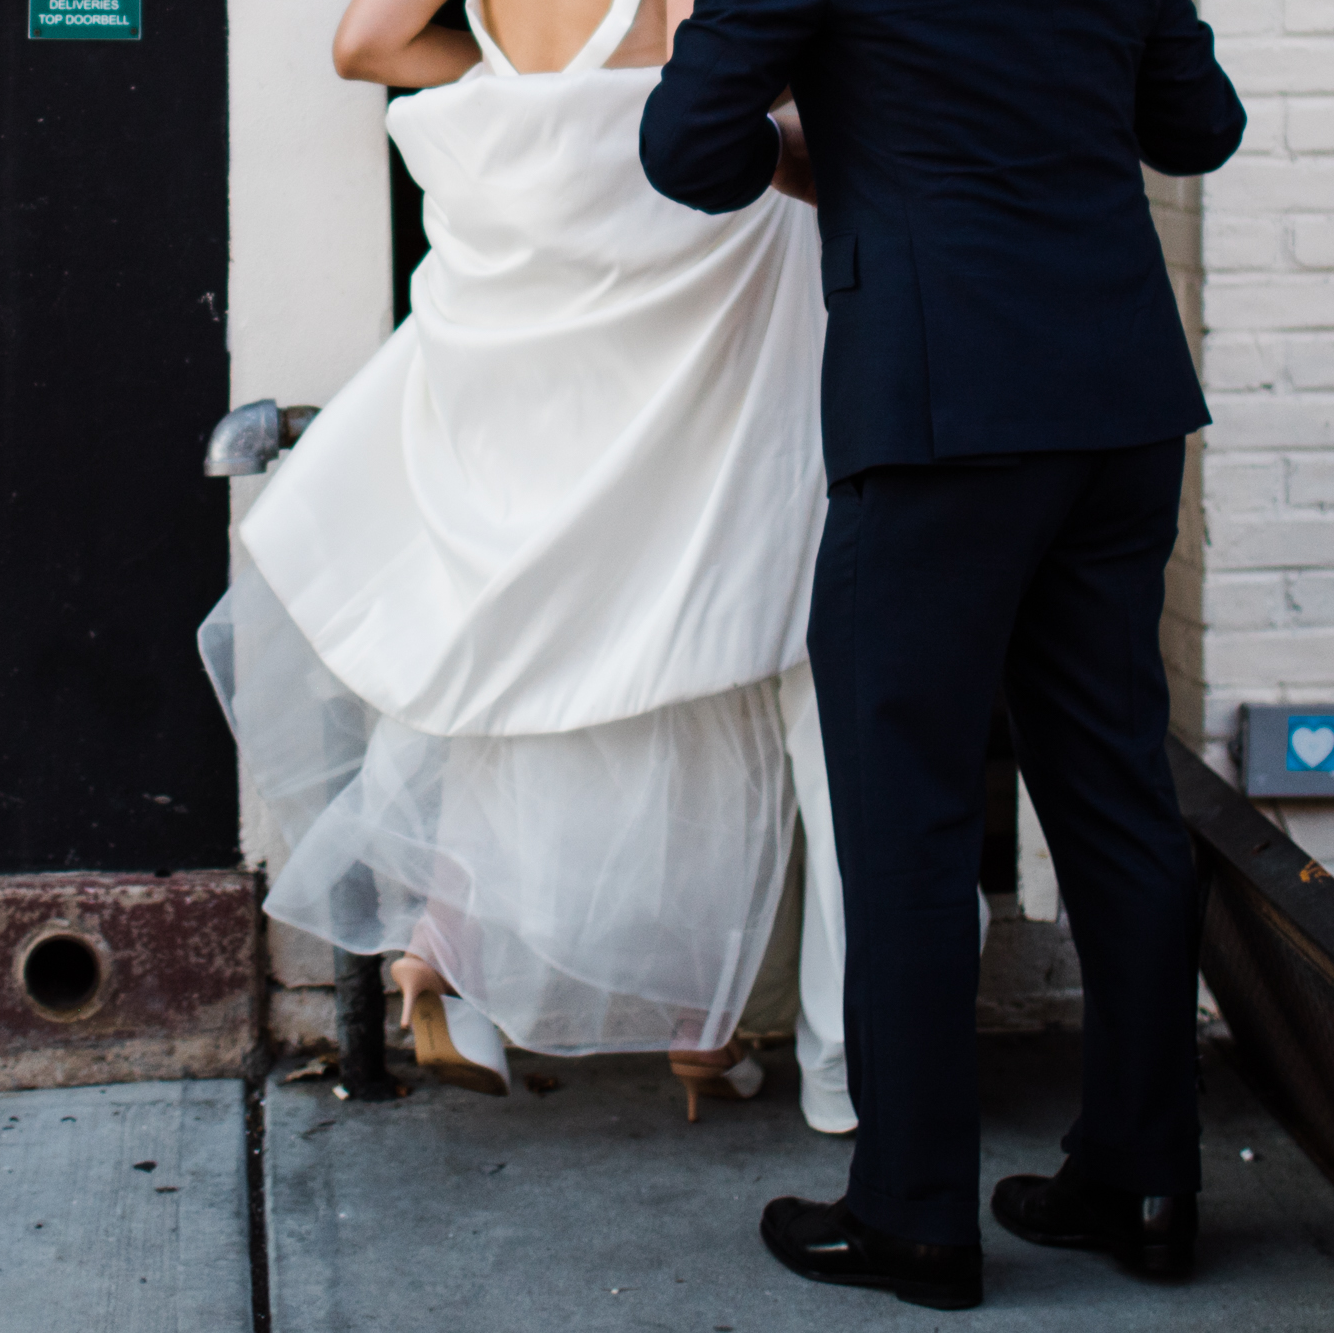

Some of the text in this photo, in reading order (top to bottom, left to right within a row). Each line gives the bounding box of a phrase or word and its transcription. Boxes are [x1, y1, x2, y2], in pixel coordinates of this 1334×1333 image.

[49, 0, 119, 10] DELIVERIES
[38, 14, 129, 26] TOP DOORBELL
